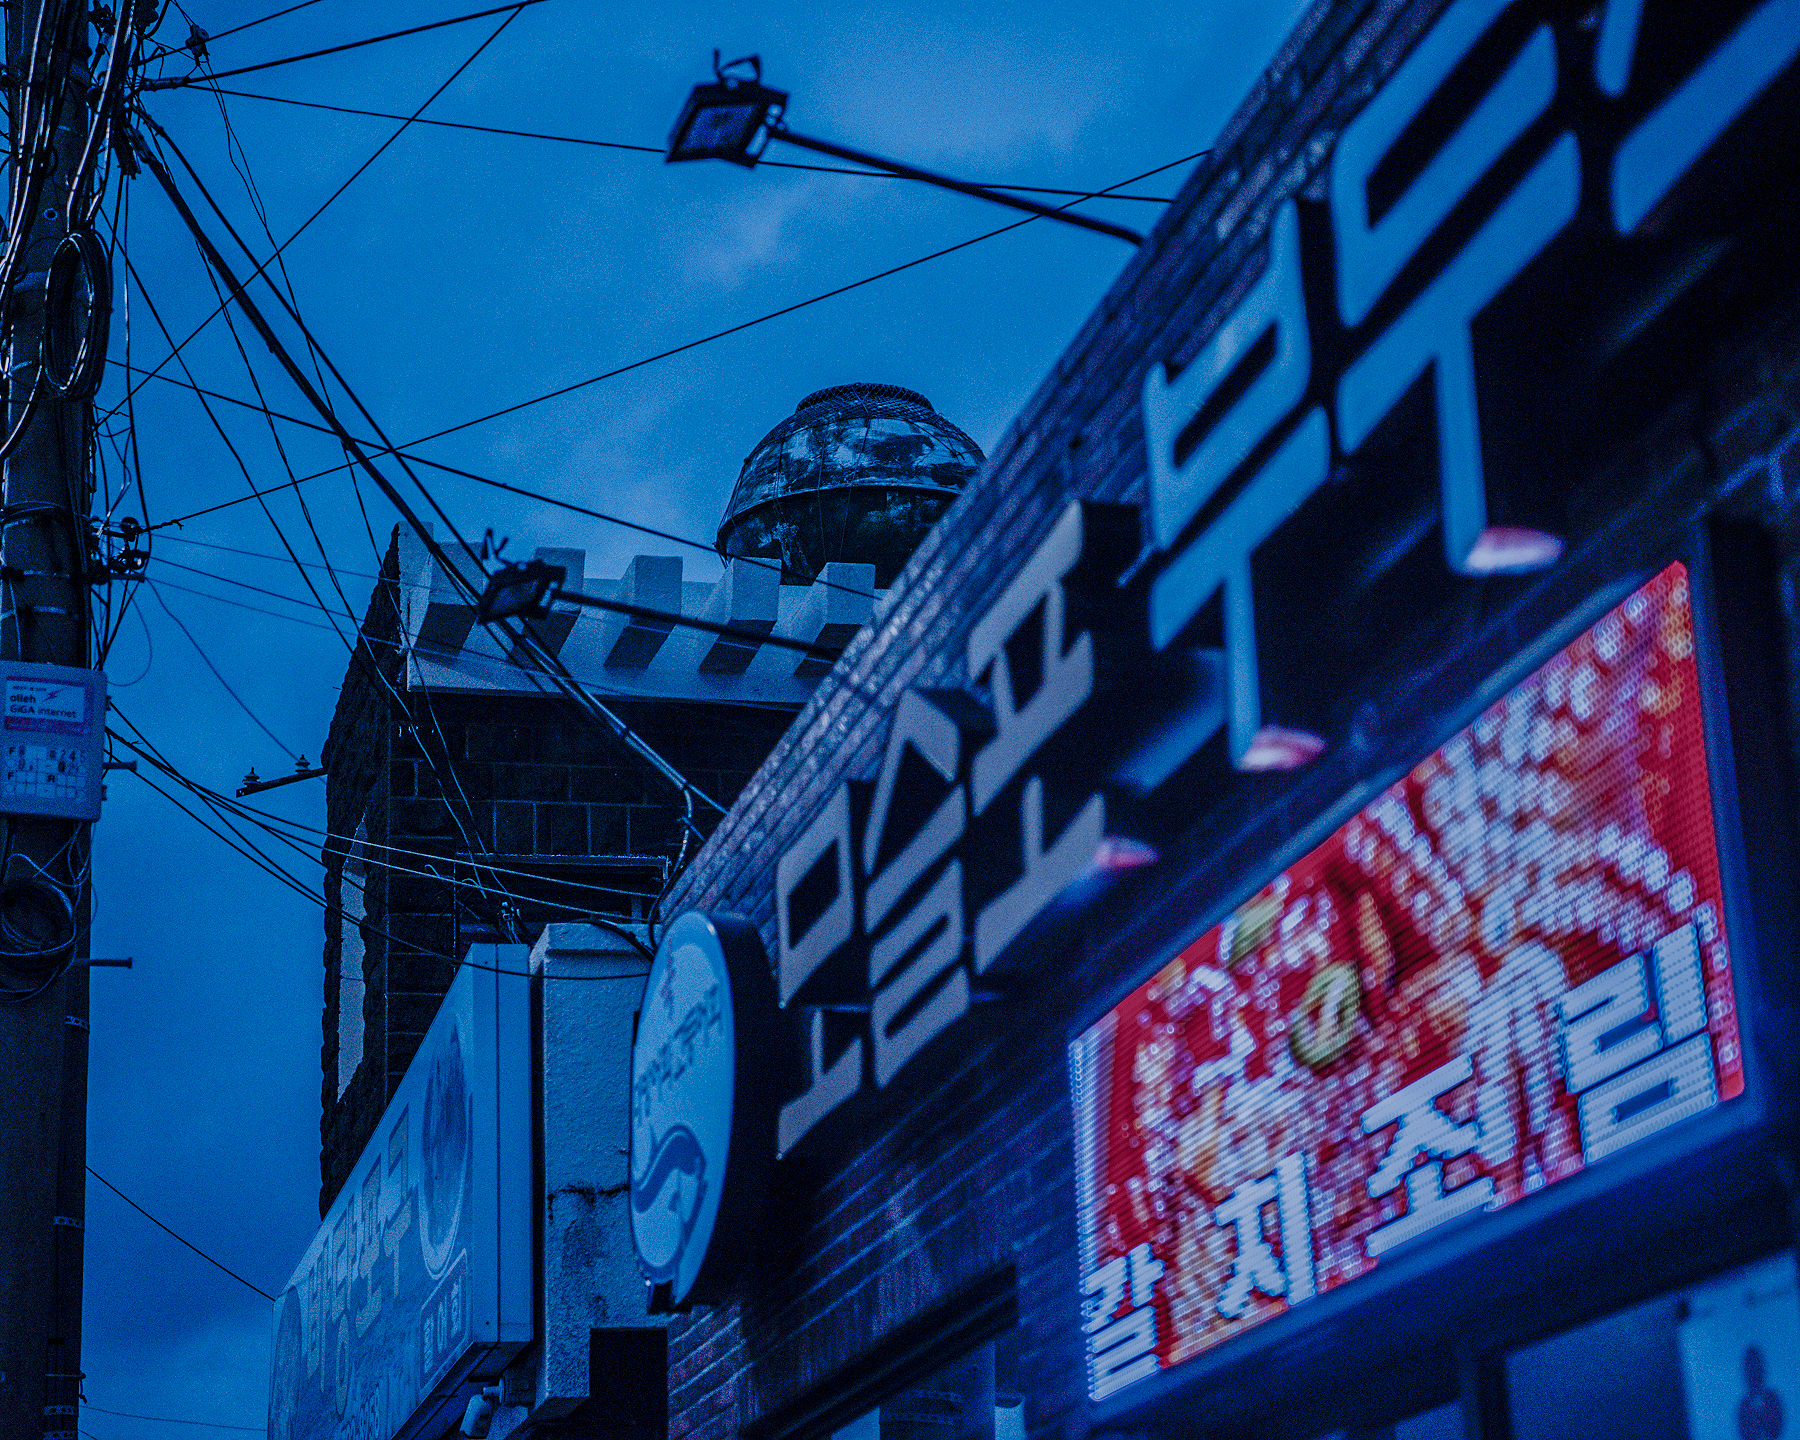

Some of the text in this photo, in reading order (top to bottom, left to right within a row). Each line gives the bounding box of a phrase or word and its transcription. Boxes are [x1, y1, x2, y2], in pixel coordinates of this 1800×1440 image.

[10, 693, 36, 703] olleh
[38, 708, 77, 719] internet
[776, 498, 1105, 1161] 모슬포
[306, 1102, 412, 1416] 바당포구
[1081, 920, 1719, 1402] 갈치조림
[423, 1276, 462, 1374] 활어회
